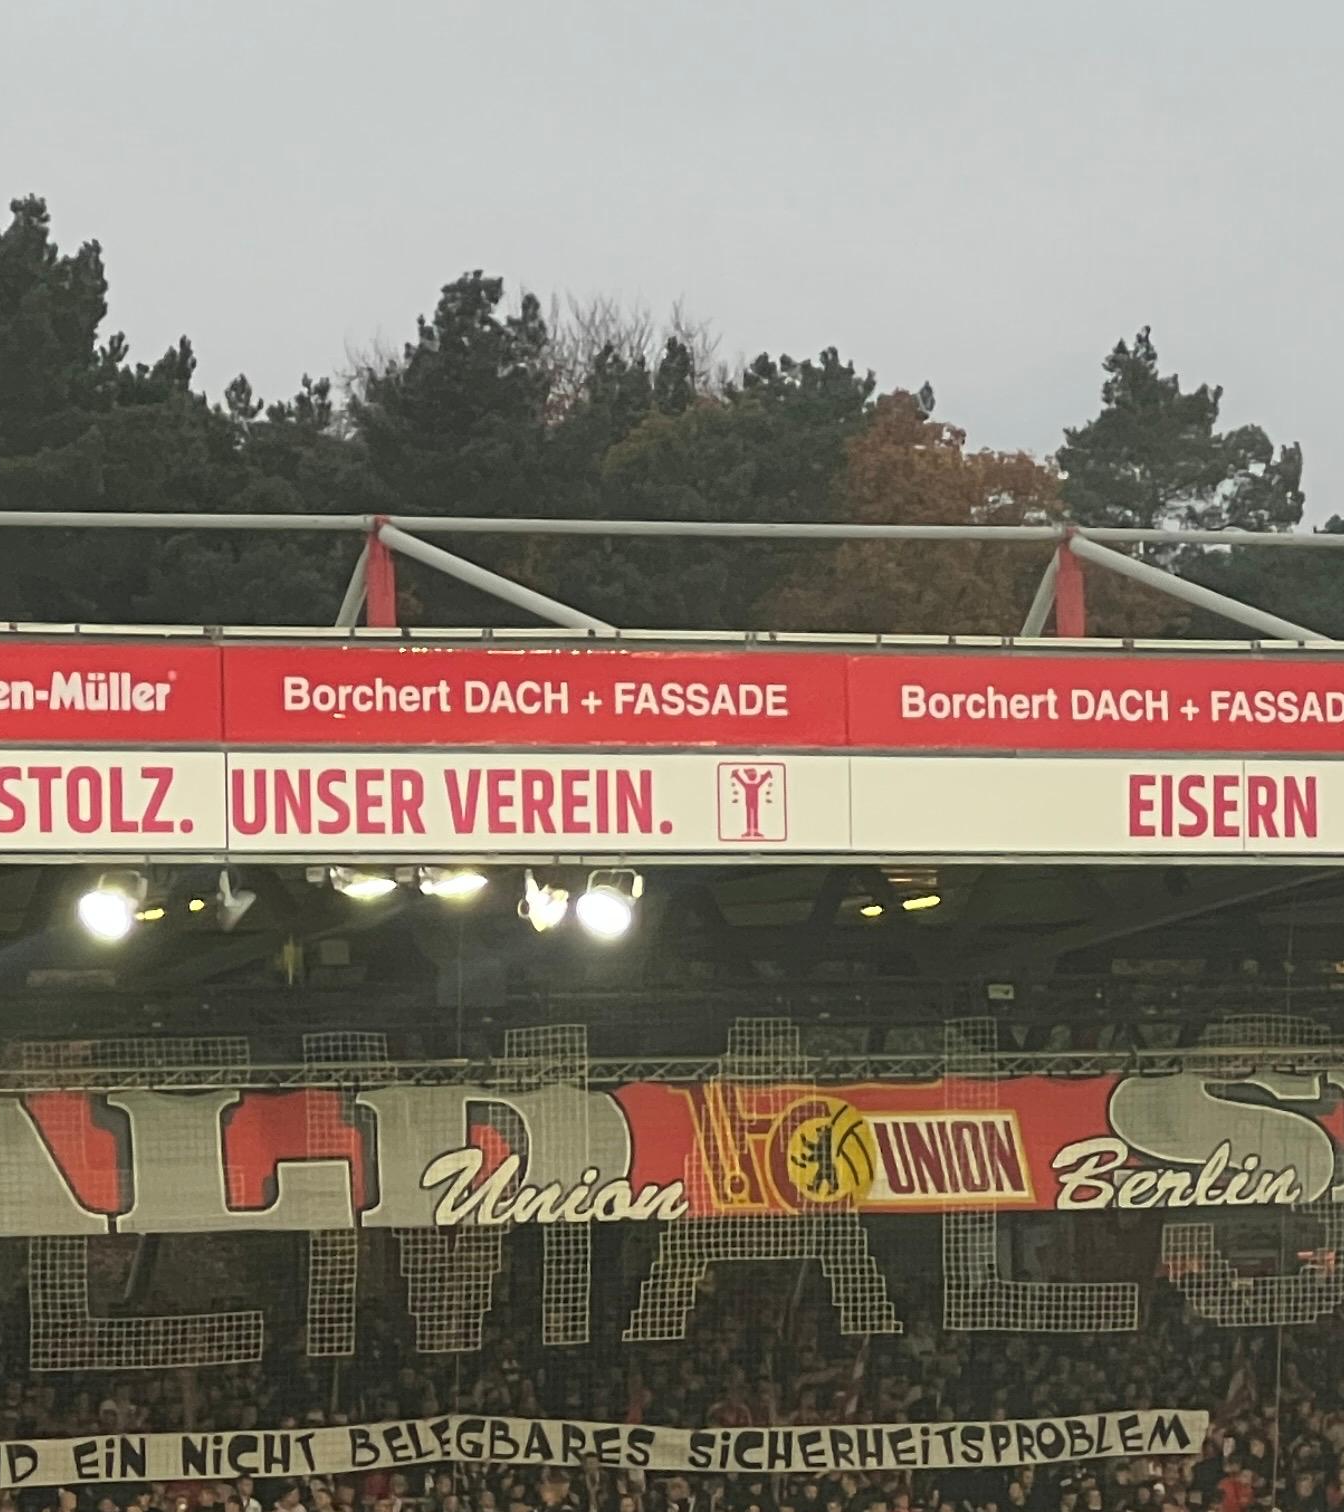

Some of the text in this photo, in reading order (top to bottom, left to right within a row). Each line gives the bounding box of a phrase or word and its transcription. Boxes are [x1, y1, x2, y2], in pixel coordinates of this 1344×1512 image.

[283, 676, 450, 714] Borchert
[464, 682, 568, 716] DACH
[614, 682, 789, 717] FASSADE
[901, 685, 1059, 721] Borchert
[1070, 689, 1168, 722] DACH
[231, 767, 425, 836] UNSER
[445, 768, 673, 836] VEREIN.
[1128, 775, 1318, 839] EISERN
[421, 1147, 690, 1226] Union
[873, 1120, 1029, 1195] UNION
[1052, 1138, 1303, 1210] Berlin
[349, 1417, 652, 1469] BELEGBARES
